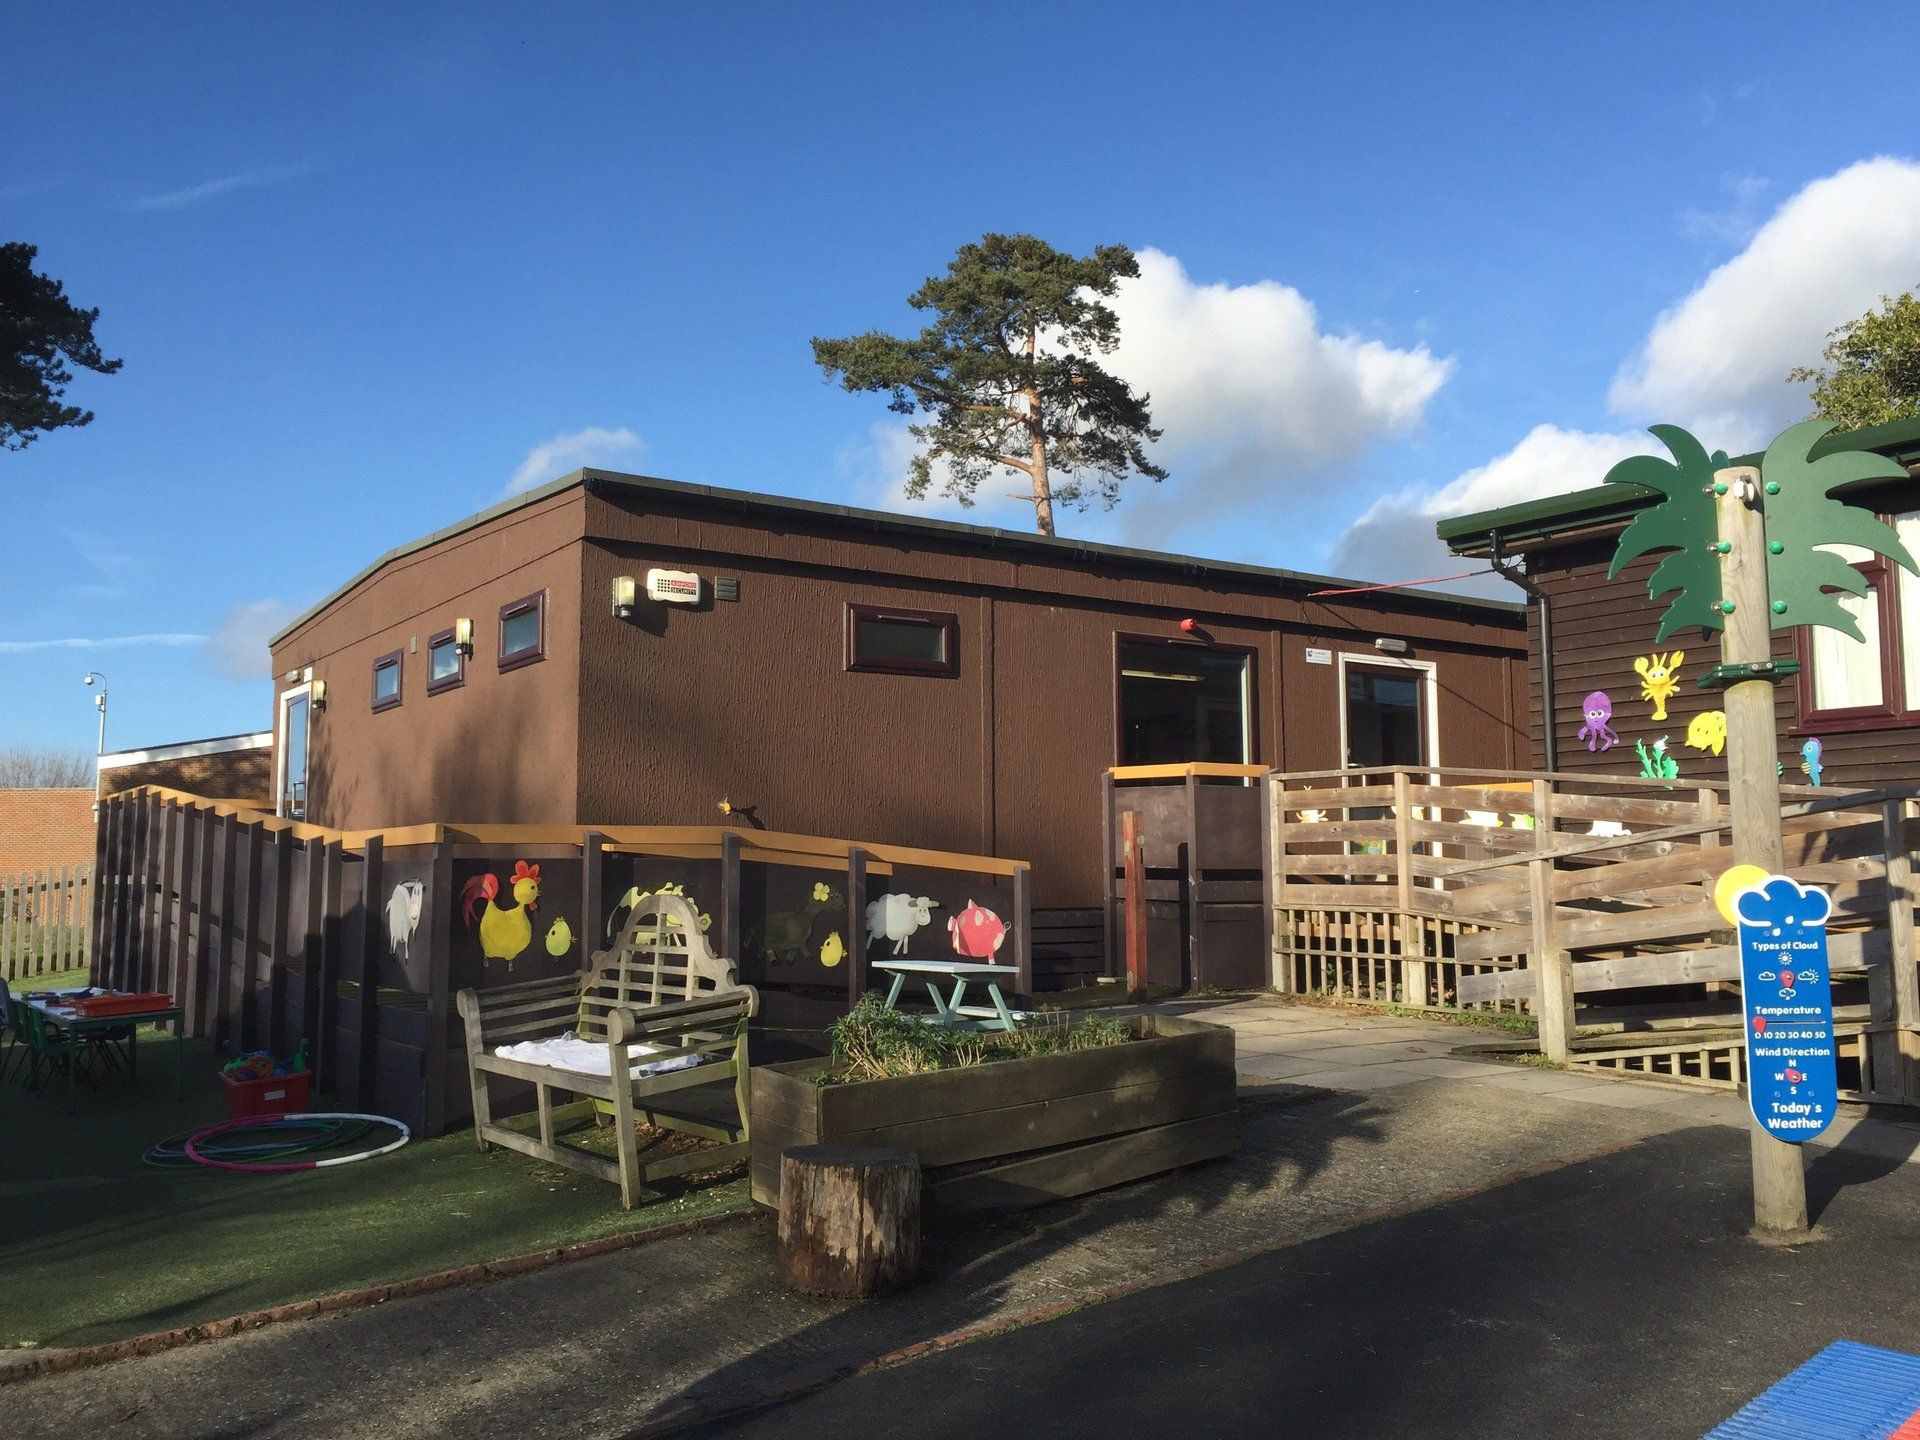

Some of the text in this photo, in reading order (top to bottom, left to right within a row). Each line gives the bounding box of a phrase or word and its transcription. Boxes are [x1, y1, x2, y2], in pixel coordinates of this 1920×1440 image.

[672, 587, 695, 595] SECURITY
[1752, 941, 1818, 951] Types of Cloud
[1755, 1006, 1821, 1015] Temperature
[1755, 1031, 1826, 1039] 0 10 20 30 40 50
[1755, 1048, 1830, 1056] Wind Direction
[1788, 1059, 1797, 1067] N
[1774, 1073, 1808, 1081] W E
[1790, 1086, 1797, 1094] S
[1767, 1117, 1823, 1129] Weather
